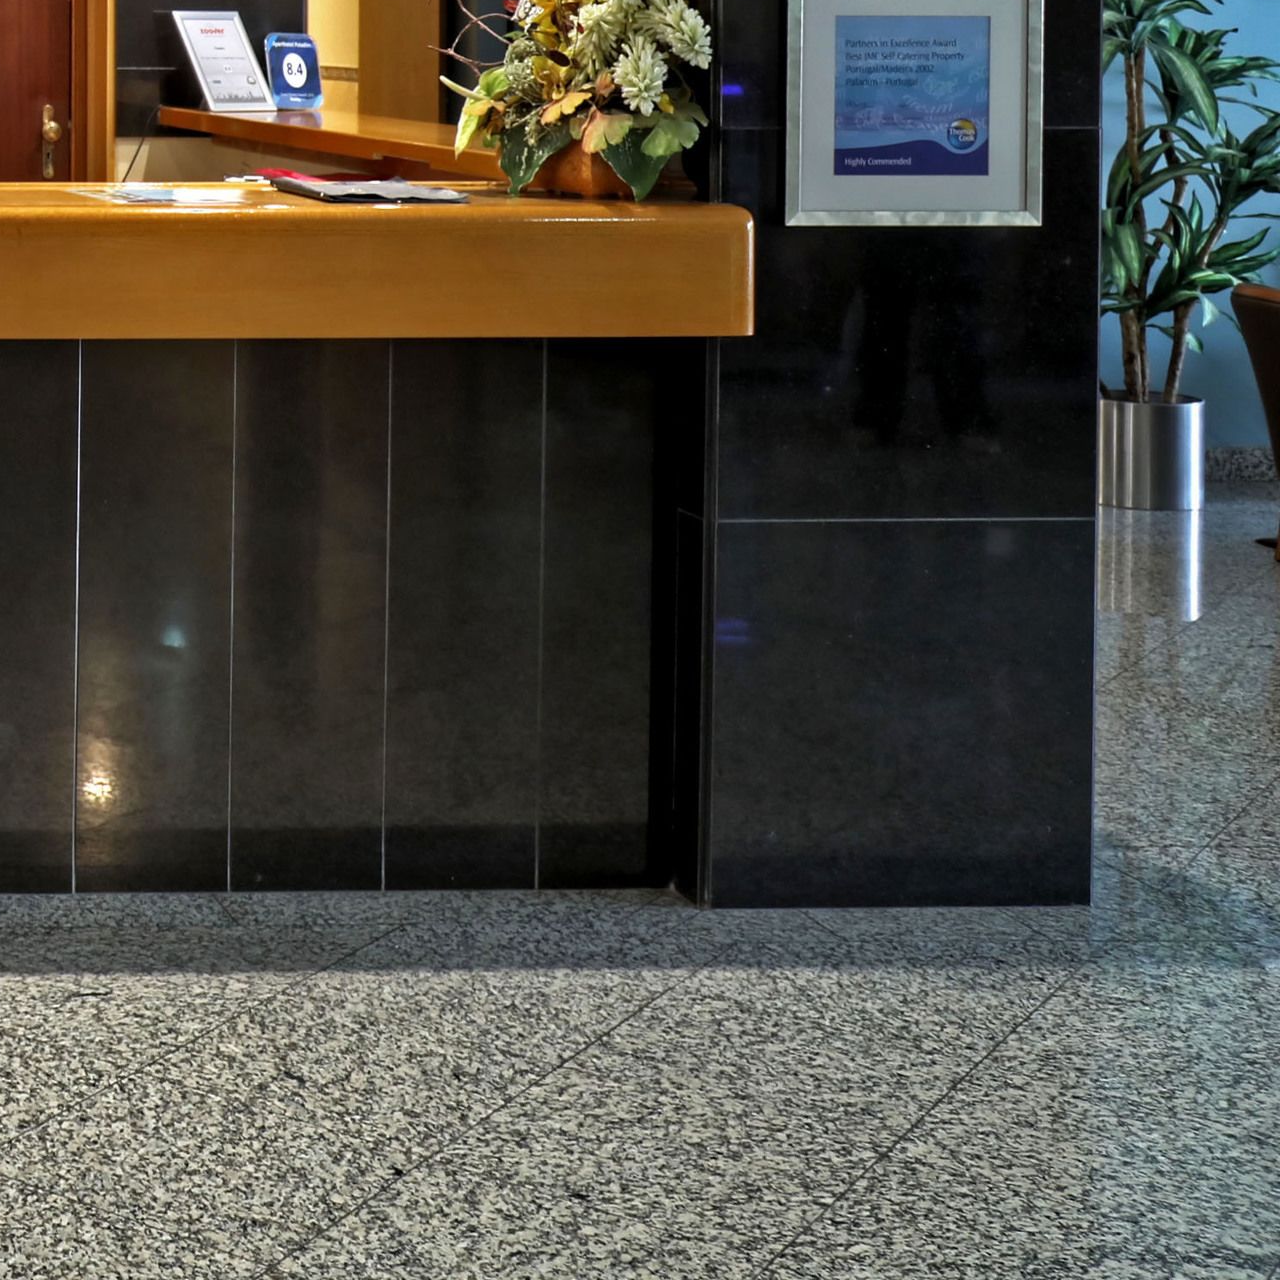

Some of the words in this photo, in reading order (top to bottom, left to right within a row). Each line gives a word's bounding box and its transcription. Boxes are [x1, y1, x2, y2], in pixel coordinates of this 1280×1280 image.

[845, 39, 878, 48] Partners
[880, 39, 888, 47] in
[890, 39, 930, 47] Excellence
[932, 39, 957, 47] Award
[931, 52, 965, 61] Property
[286, 62, 303, 75] 8.4
[949, 128, 975, 136] Thomas
[958, 134, 975, 142] Cook
[844, 157, 866, 167] Highly
[867, 157, 912, 165] Commended
